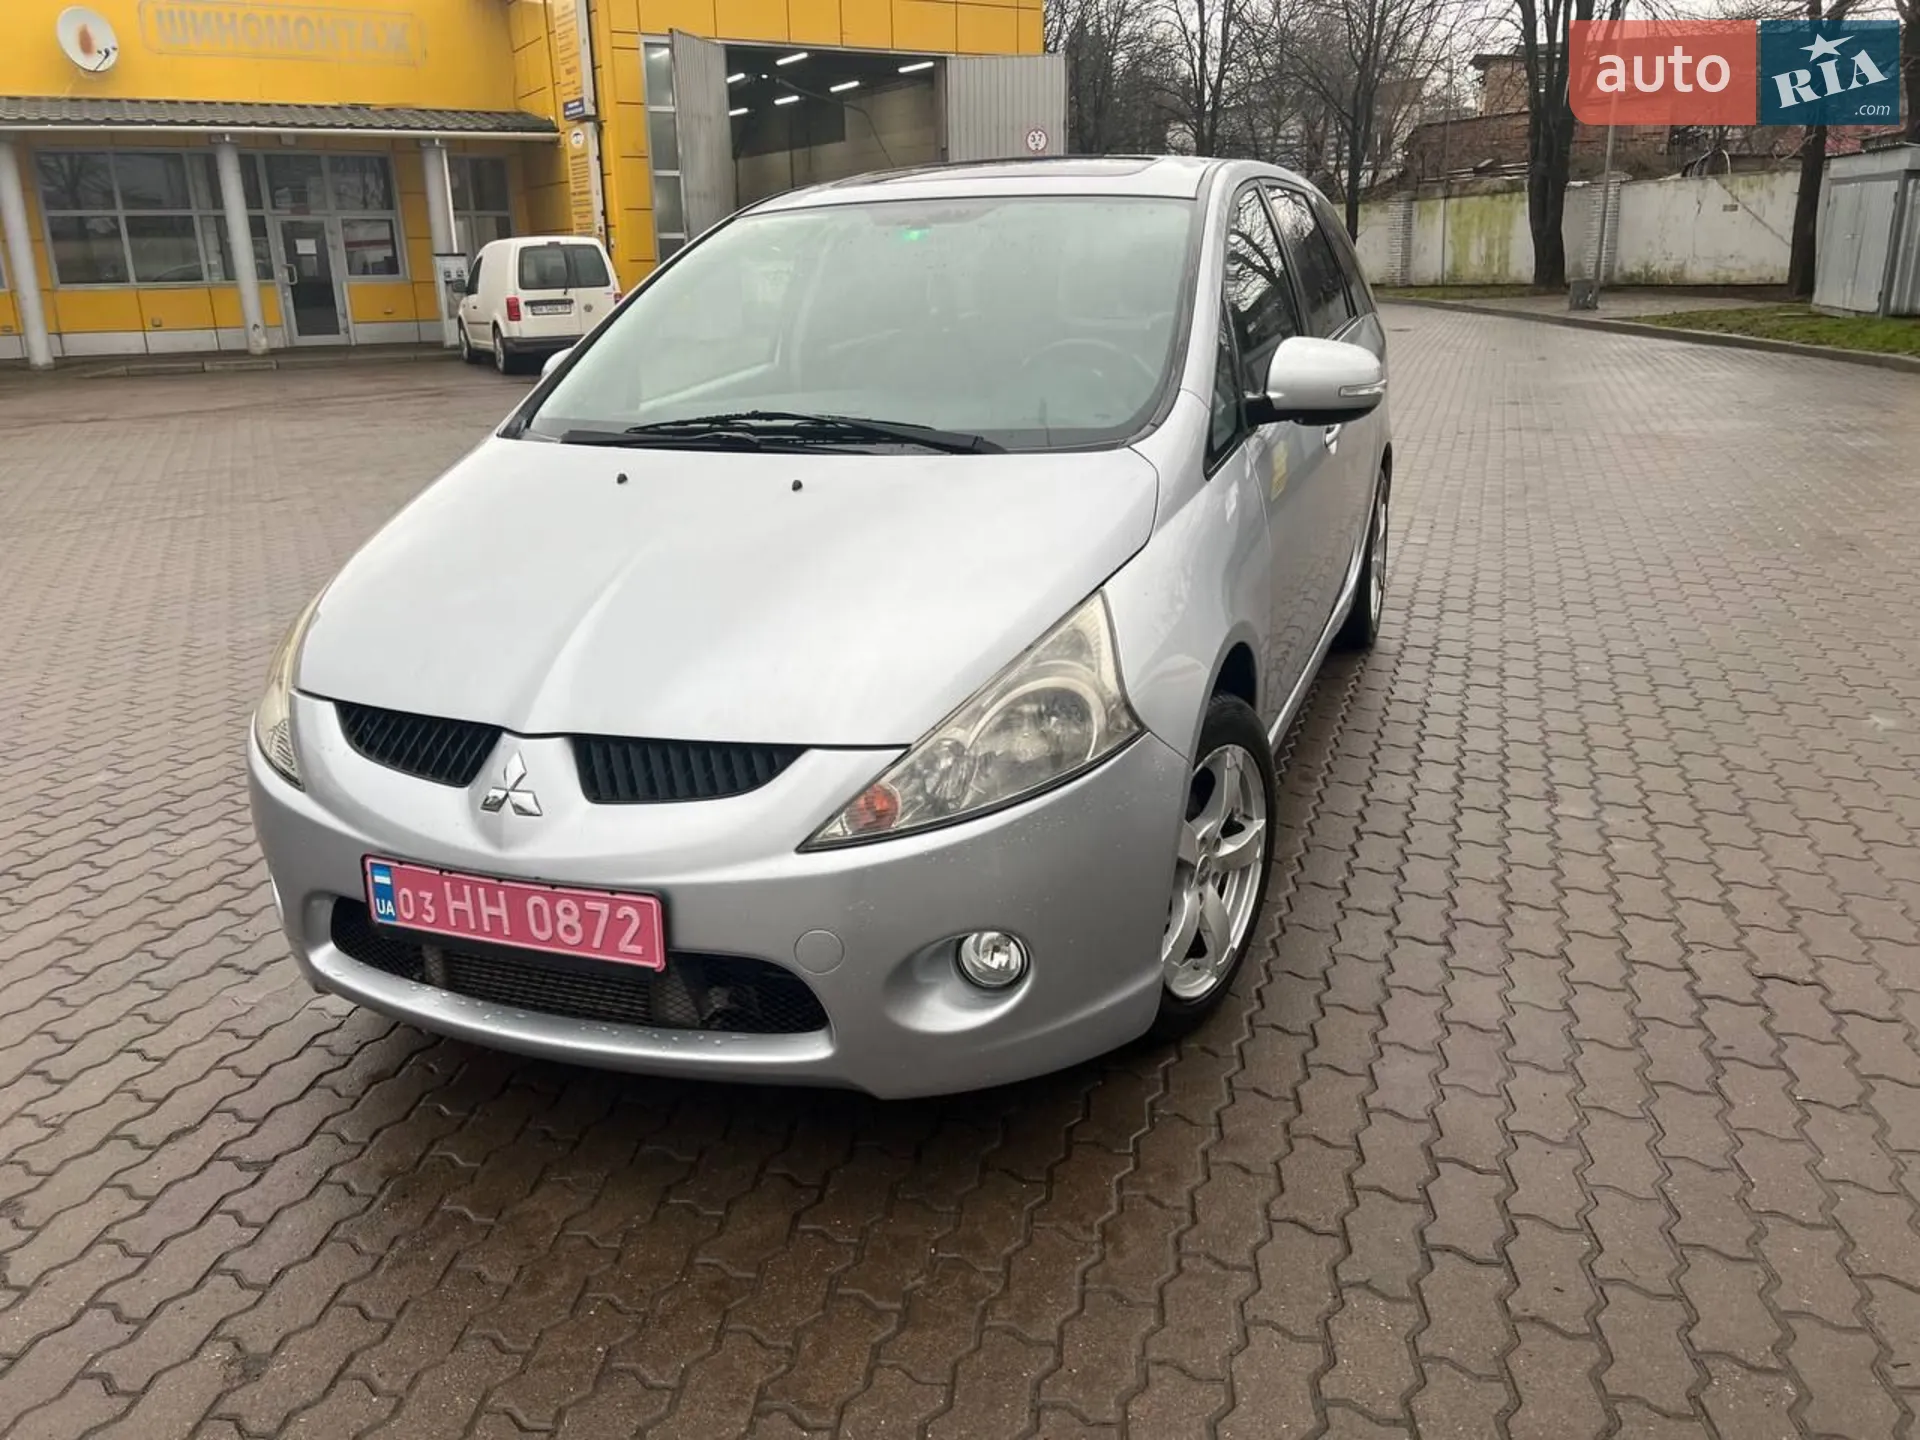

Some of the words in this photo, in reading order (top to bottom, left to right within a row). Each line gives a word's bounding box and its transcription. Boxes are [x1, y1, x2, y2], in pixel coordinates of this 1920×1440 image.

[155, 9, 412, 55] ШИНОМОНТАЖ
[376, 897, 396, 917] UA
[399, 887, 436, 924] 03
[444, 881, 511, 936] HH
[526, 895, 644, 955] 0872
